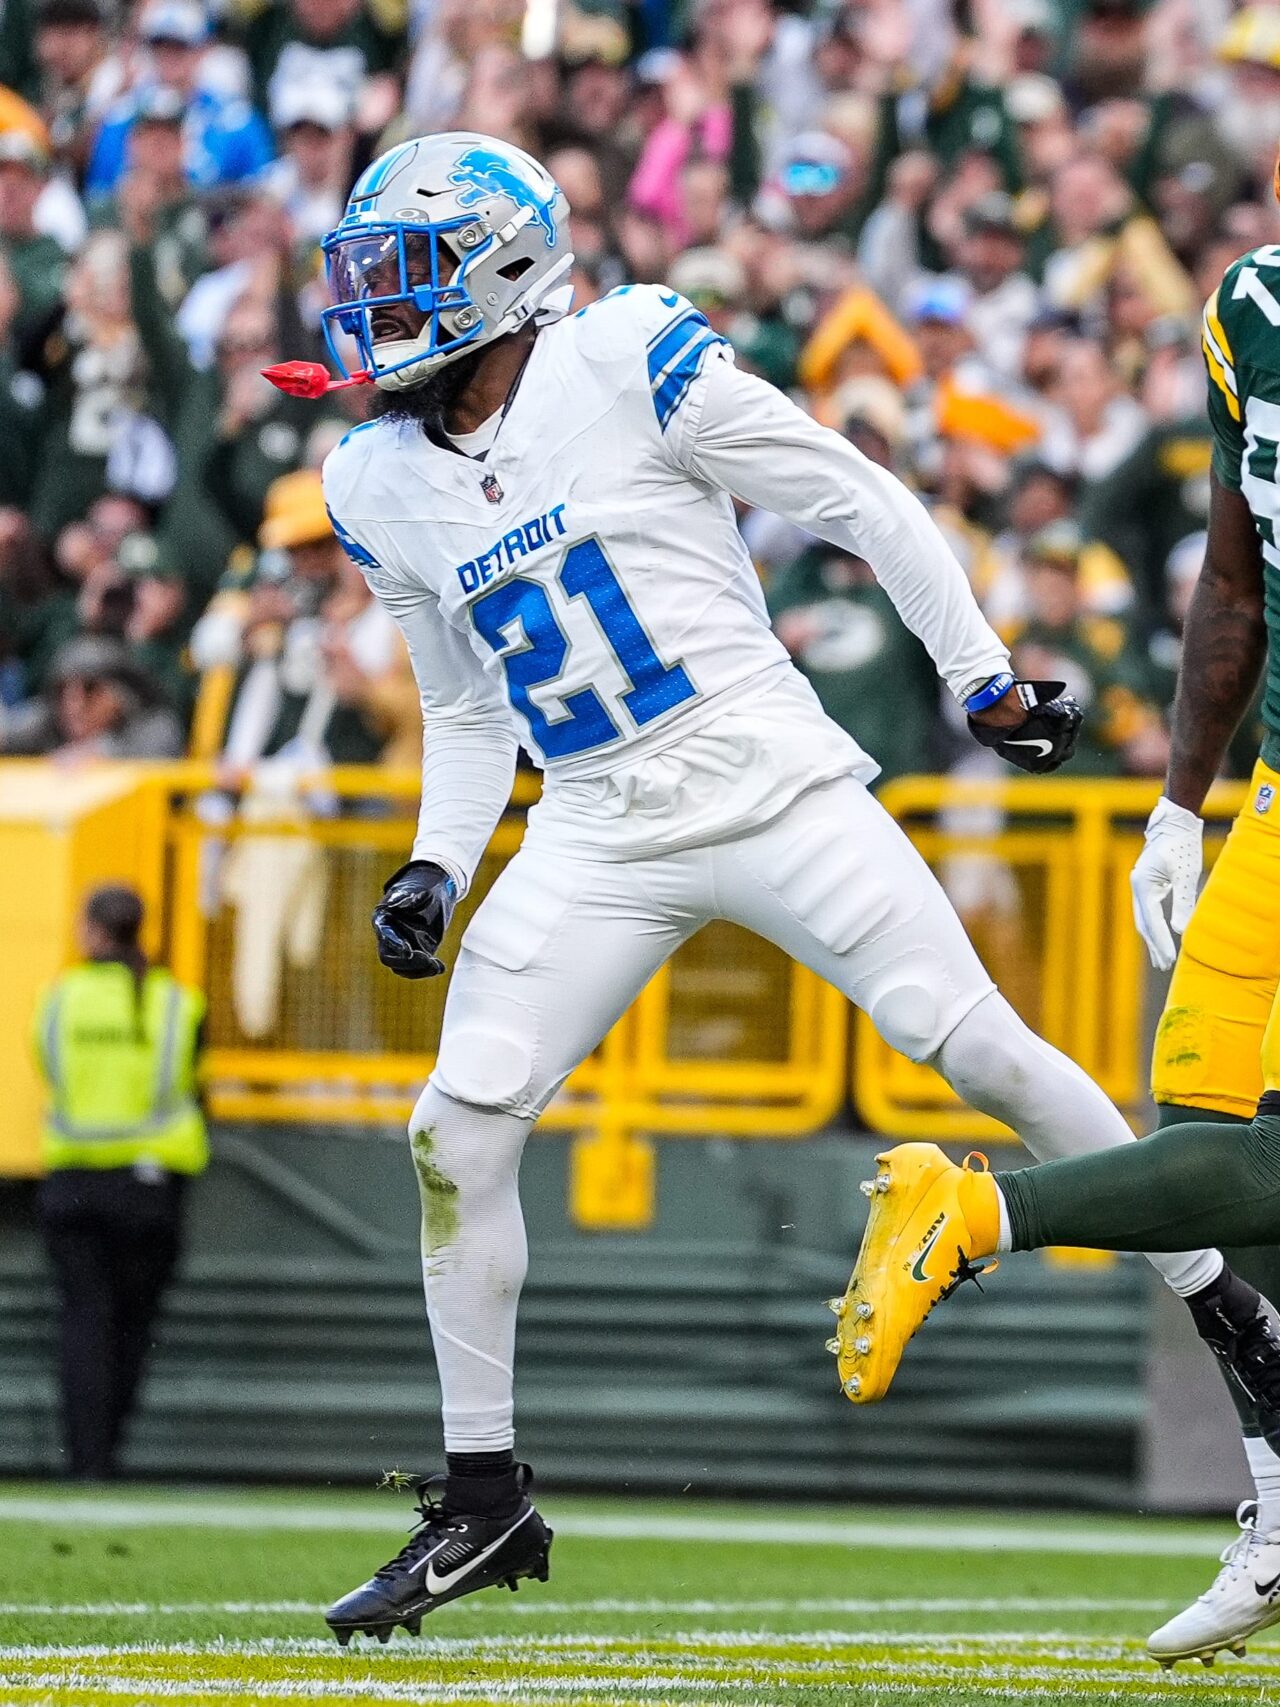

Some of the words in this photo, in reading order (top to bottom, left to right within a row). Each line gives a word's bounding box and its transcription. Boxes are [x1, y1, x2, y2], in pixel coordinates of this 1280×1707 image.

[456, 503, 567, 595] DETROIT
[467, 531, 704, 764] 21
[902, 1242, 925, 1272] ZM
